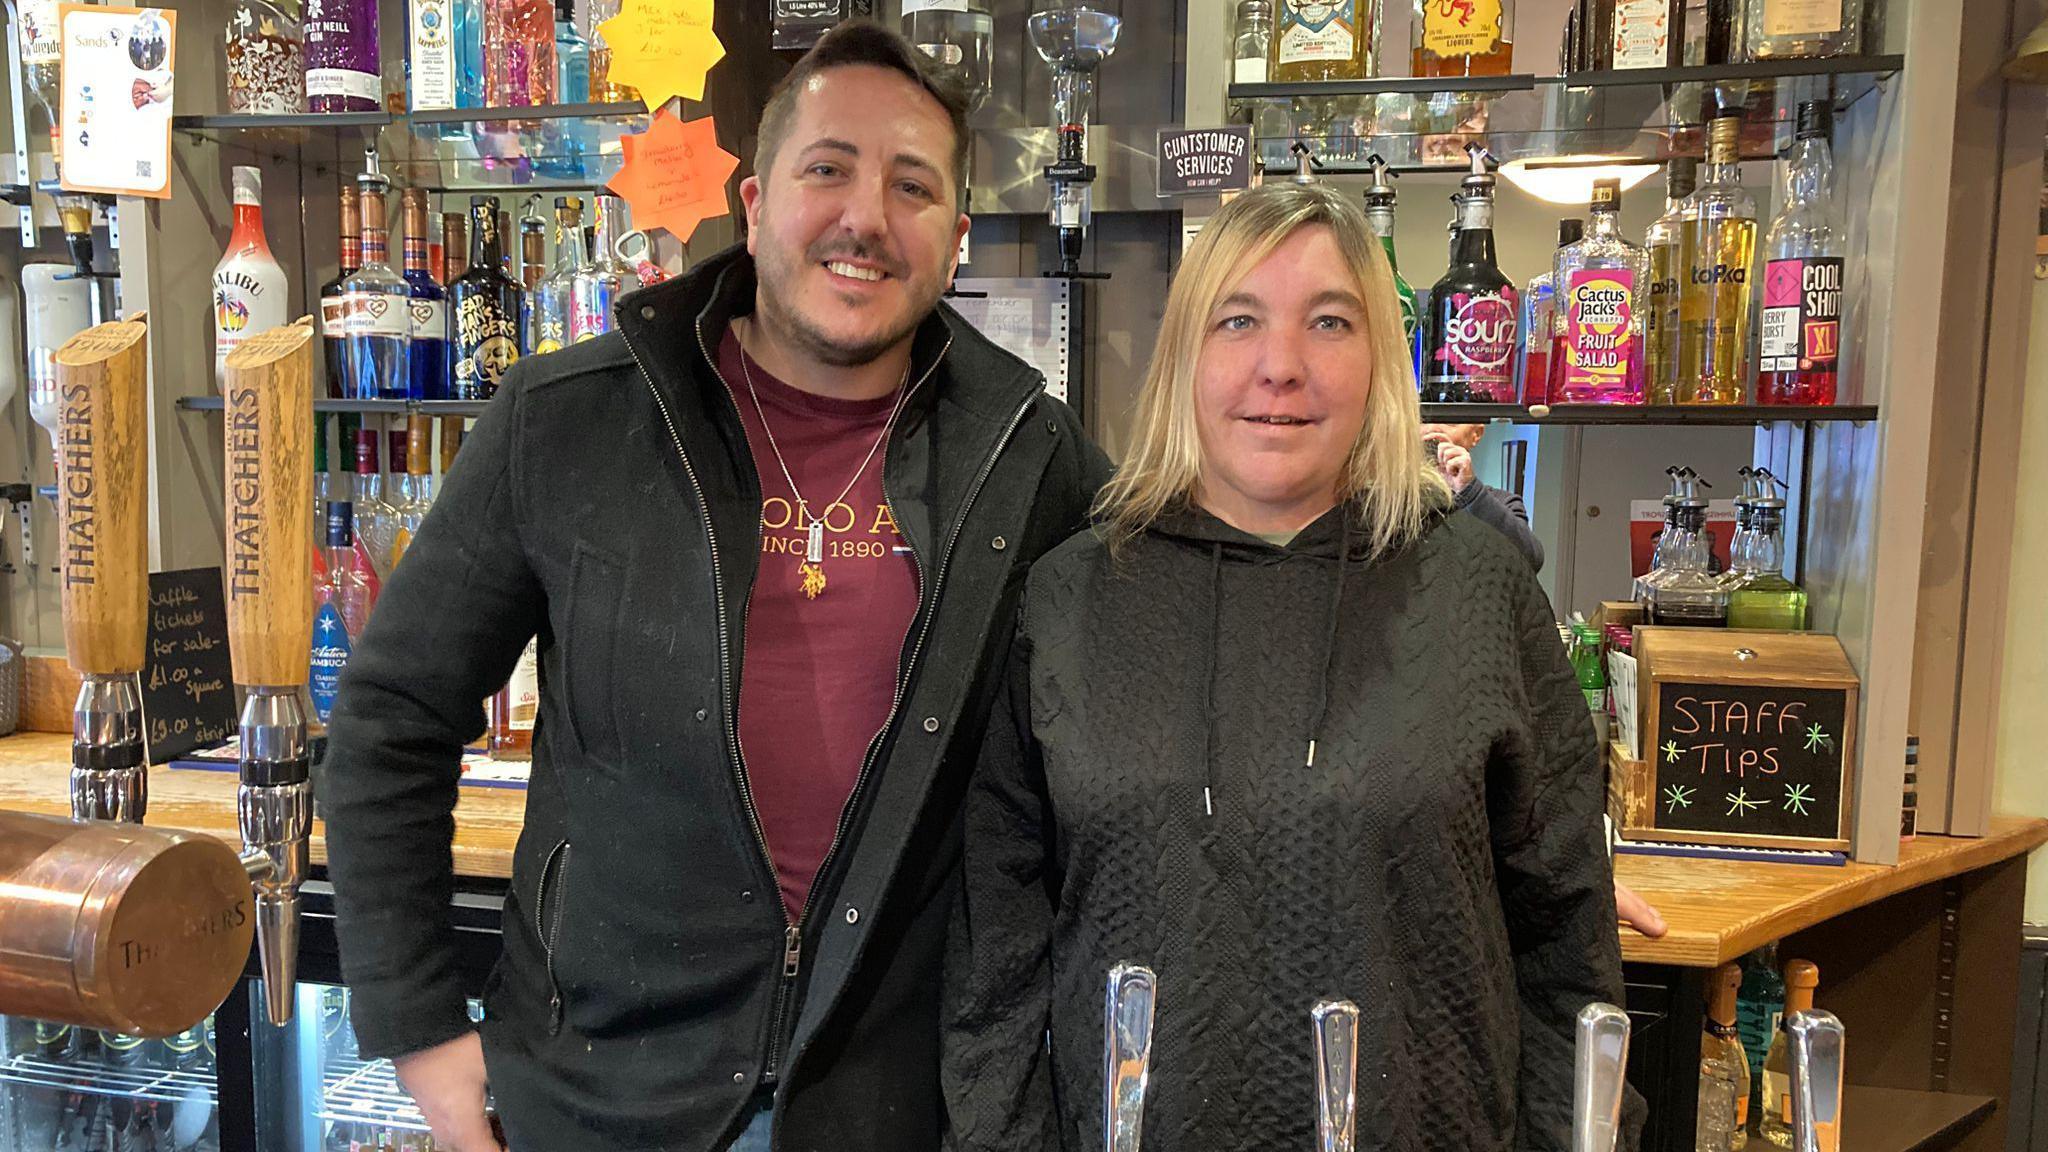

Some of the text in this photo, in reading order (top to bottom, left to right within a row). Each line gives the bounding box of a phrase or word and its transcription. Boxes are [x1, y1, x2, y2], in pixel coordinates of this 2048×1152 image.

[310, 32, 324, 42] GIN
[323, 22, 350, 32] NEILL
[75, 34, 109, 48] Sands
[1163, 132, 1245, 160] CUNTSTOMER
[1176, 154, 1233, 178] SERVICES
[1802, 264, 1841, 292] COOL
[1577, 286, 1625, 302] Cactus
[1806, 291, 1842, 317] SHOT
[1579, 301, 1616, 322] Jack's
[1764, 311, 1787, 325] BERRY
[460, 320, 517, 349] FINGERS
[1578, 334, 1618, 350] FRUIT
[1763, 324, 1785, 338] BURST
[1813, 326, 1833, 355] XL
[1464, 345, 1506, 354] RASPBERRY
[1576, 351, 1619, 367] SALAD
[61, 384, 95, 591] THATCHERS
[230, 388, 260, 602] THATCHERS
[763, 497, 856, 533] OLO
[762, 535, 885, 558] INC 1890
[154, 610, 205, 631] tickets
[154, 637, 177, 657] for
[149, 663, 188, 691] £1.00
[1672, 697, 1808, 736] STAFF
